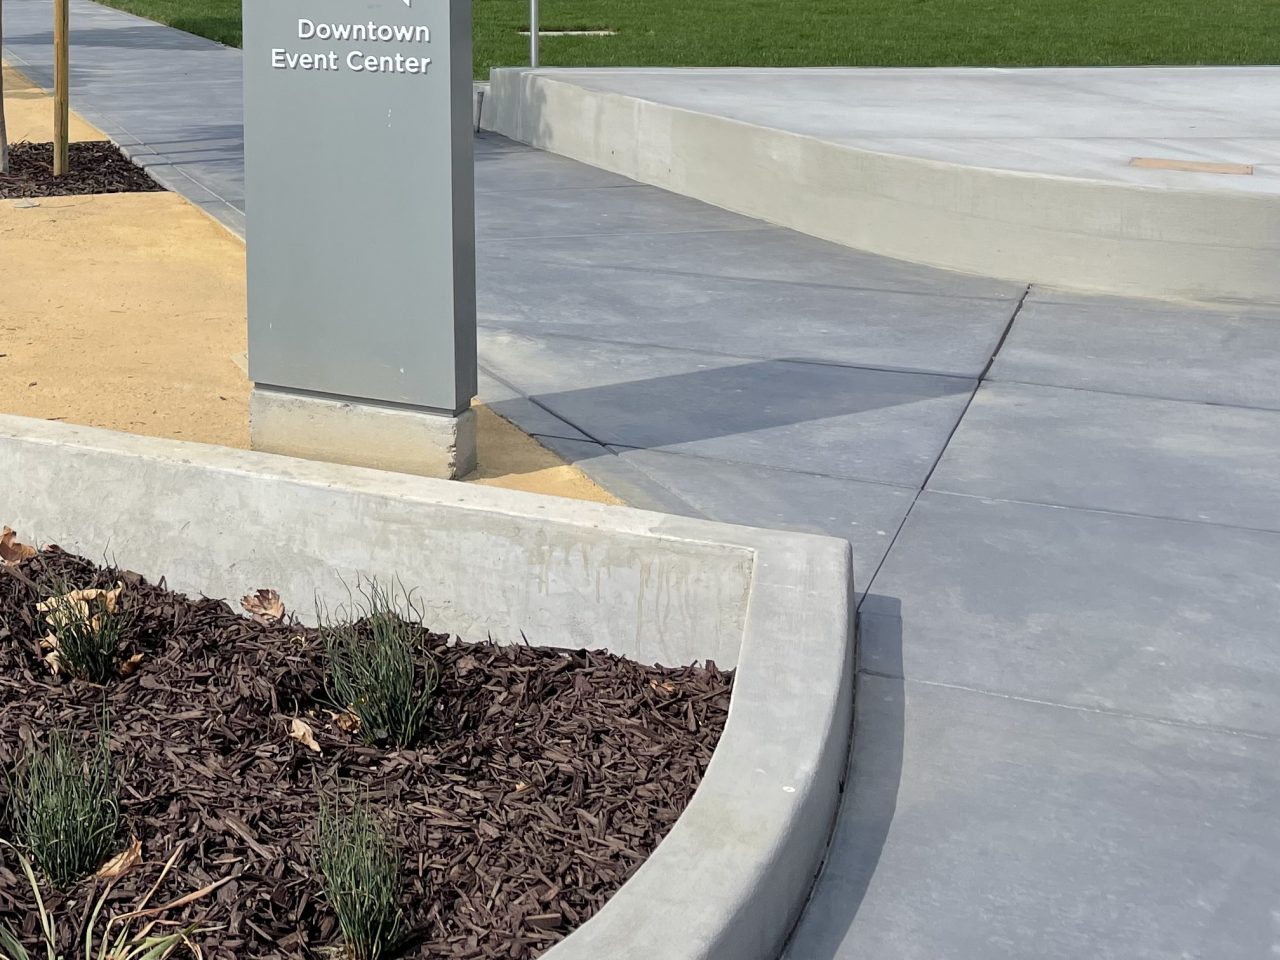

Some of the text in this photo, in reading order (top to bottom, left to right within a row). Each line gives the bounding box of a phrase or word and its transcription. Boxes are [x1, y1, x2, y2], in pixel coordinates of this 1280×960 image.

[298, 18, 430, 42] Downtown
[271, 48, 431, 73] Event Center
